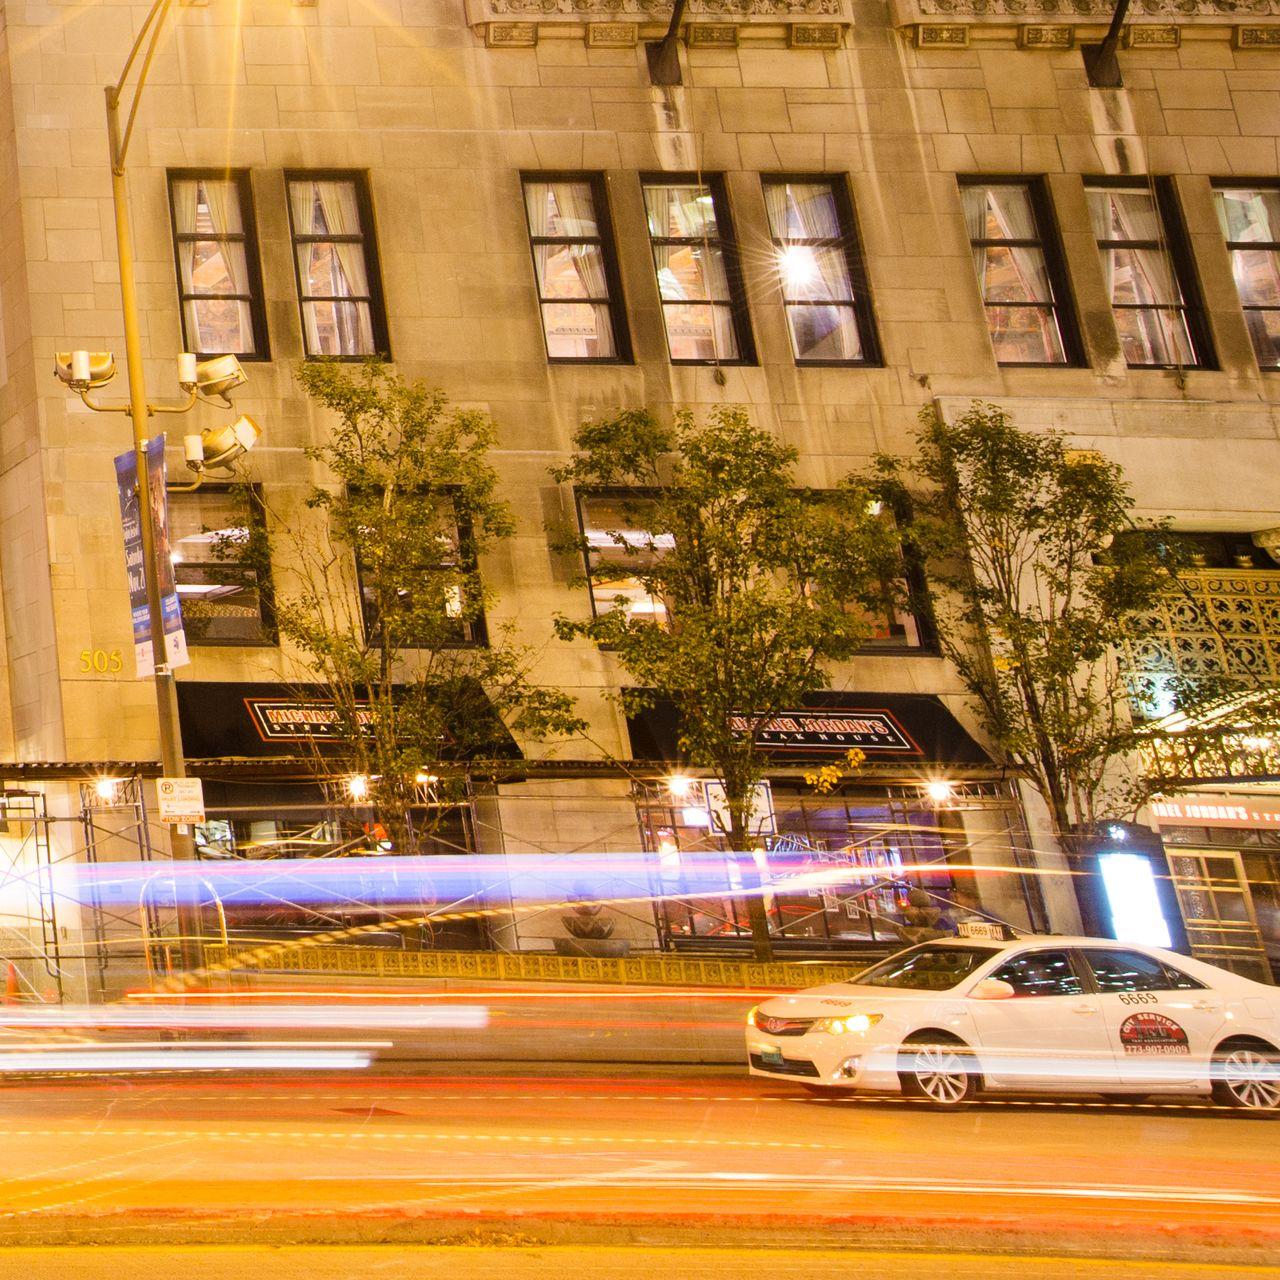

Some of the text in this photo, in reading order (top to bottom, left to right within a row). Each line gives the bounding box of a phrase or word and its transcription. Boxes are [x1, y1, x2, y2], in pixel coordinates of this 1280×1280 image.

[79, 648, 123, 673] 505
[731, 731, 896, 742] SEAK HOUSE
[1118, 992, 1159, 1006] 6669
[1136, 1013, 1180, 1031] SERVICE
[1125, 1045, 1188, 1055] 773-907-0909
